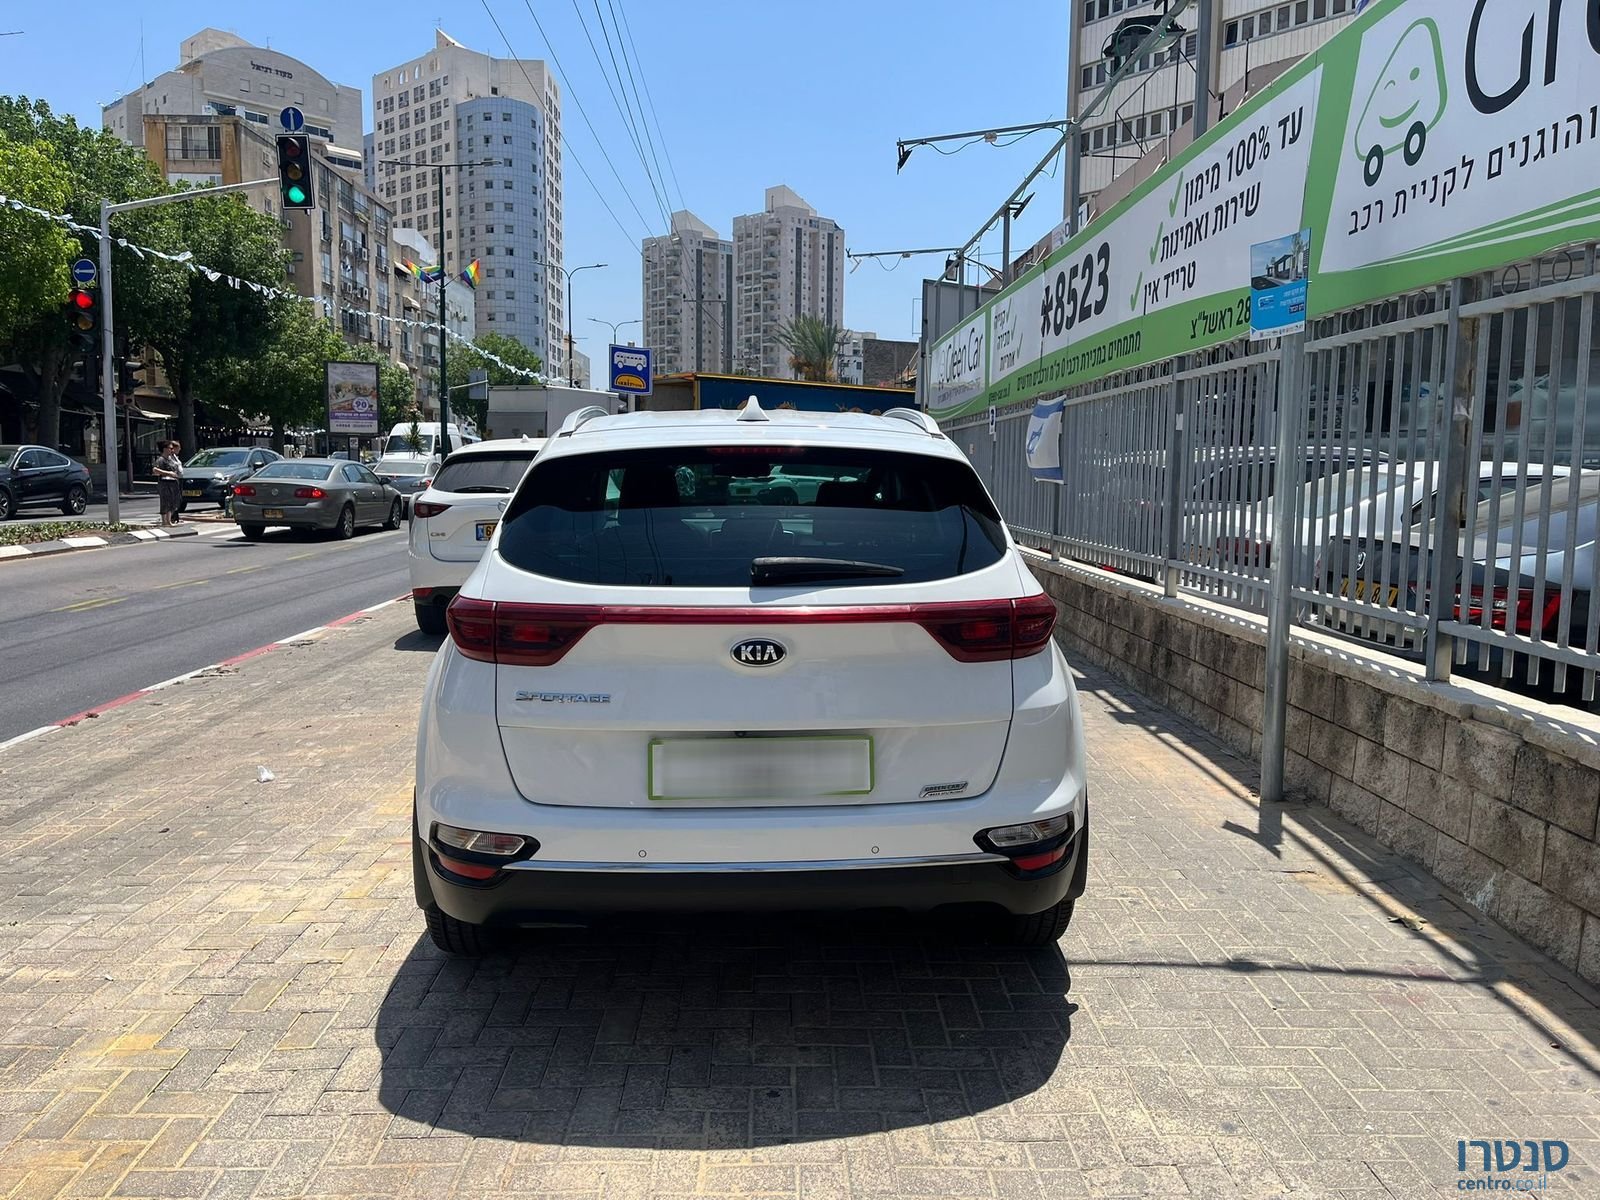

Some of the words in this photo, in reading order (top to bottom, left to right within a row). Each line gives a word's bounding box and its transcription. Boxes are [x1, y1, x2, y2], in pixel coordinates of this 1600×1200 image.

[1278, 106, 1304, 150] עד
[1487, 104, 1598, 181] והוגנים
[1226, 125, 1270, 183] 100%
[1184, 162, 1221, 217] מימון
[1391, 154, 1475, 218] לקניית
[1212, 181, 1261, 236] שירות
[1348, 199, 1384, 236] רכב
[1160, 211, 1210, 263] ואמינות
[1144, 278, 1160, 315] אין
[1163, 260, 1196, 298] טרייד
[945, 343, 966, 383] Green
[968, 327, 984, 371] Car
[1080, 345, 1106, 371] במכירת
[1108, 330, 1141, 361] מתמחים
[1017, 372, 1032, 391] חדשים
[1066, 355, 1079, 376] רכבי
[740, 645, 778, 661] KIA
[515, 690, 611, 703] SPORTAGE
